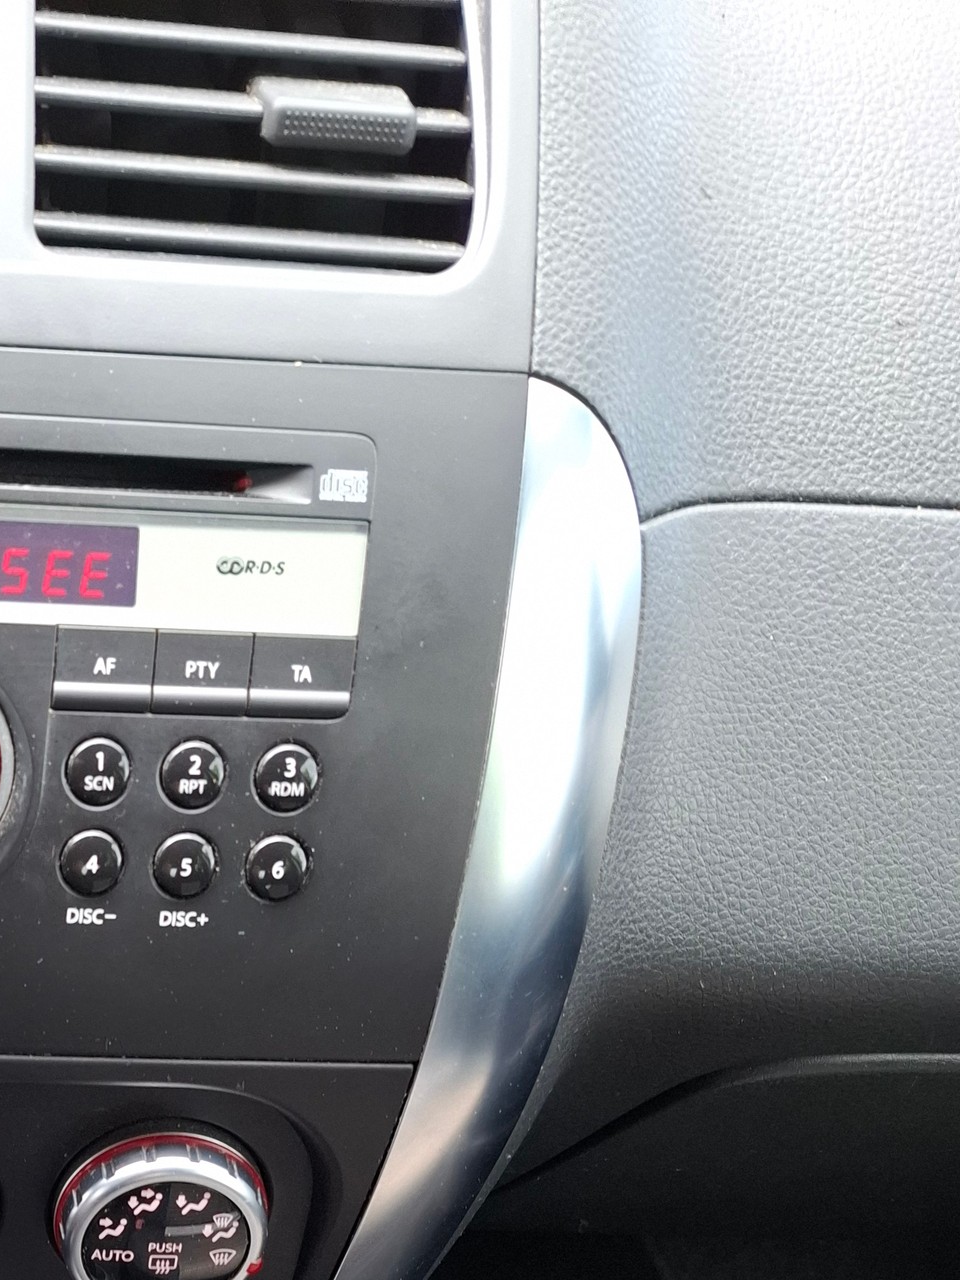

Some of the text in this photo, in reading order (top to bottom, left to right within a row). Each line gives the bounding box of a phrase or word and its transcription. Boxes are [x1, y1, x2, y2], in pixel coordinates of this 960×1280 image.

[93, 656, 117, 676] AF
[184, 660, 219, 680] PTY
[291, 663, 312, 683] TA
[94, 750, 105, 772] 1
[189, 754, 202, 776] 2
[283, 757, 297, 778] 3
[83, 775, 115, 792] SCN
[178, 779, 208, 795] RPT
[270, 781, 305, 798] RDM
[85, 854, 100, 874] 4
[180, 857, 193, 878] 5
[271, 860, 285, 880] 6
[158, 910, 210, 928] DISC+
[90, 1248, 135, 1263] AUTO
[147, 1242, 183, 1254] PUSH
